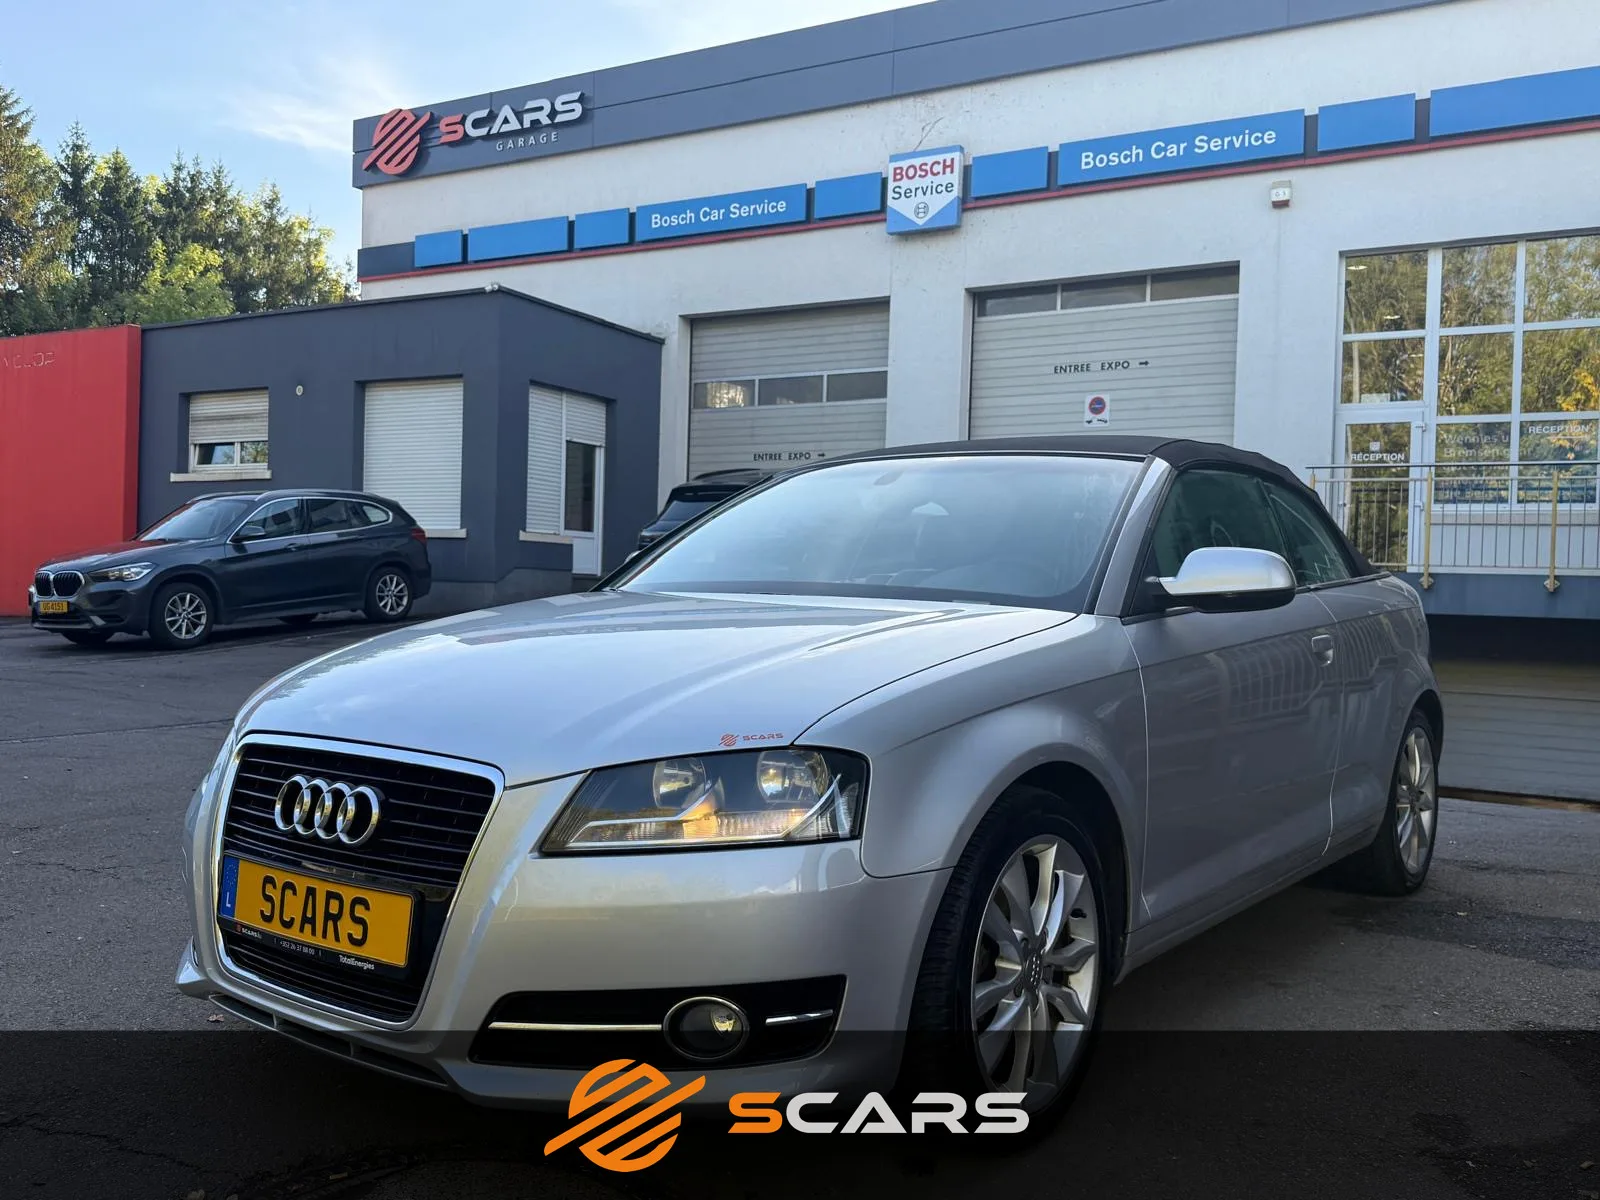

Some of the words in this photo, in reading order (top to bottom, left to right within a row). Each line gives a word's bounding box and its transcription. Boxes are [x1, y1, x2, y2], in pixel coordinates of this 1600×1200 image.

[439, 91, 583, 144] SCARS
[496, 131, 559, 151] GARAGE
[1081, 145, 1143, 170] Bosch
[1150, 140, 1188, 160] Car
[1194, 129, 1277, 153] Service
[892, 157, 956, 183] BOSCH
[891, 180, 955, 200] Service
[651, 209, 696, 228] Bosch
[699, 204, 726, 222] Car
[730, 199, 787, 218] Service
[1053, 363, 1091, 374] ENTREE
[1100, 360, 1130, 370] EXPO
[753, 452, 783, 461] ENTREE
[787, 451, 812, 460] EXPO
[742, 733, 784, 741] SCARS
[225, 892, 231, 908] L
[260, 875, 371, 947] SCARS
[339, 955, 375, 970] TotalEnergies
